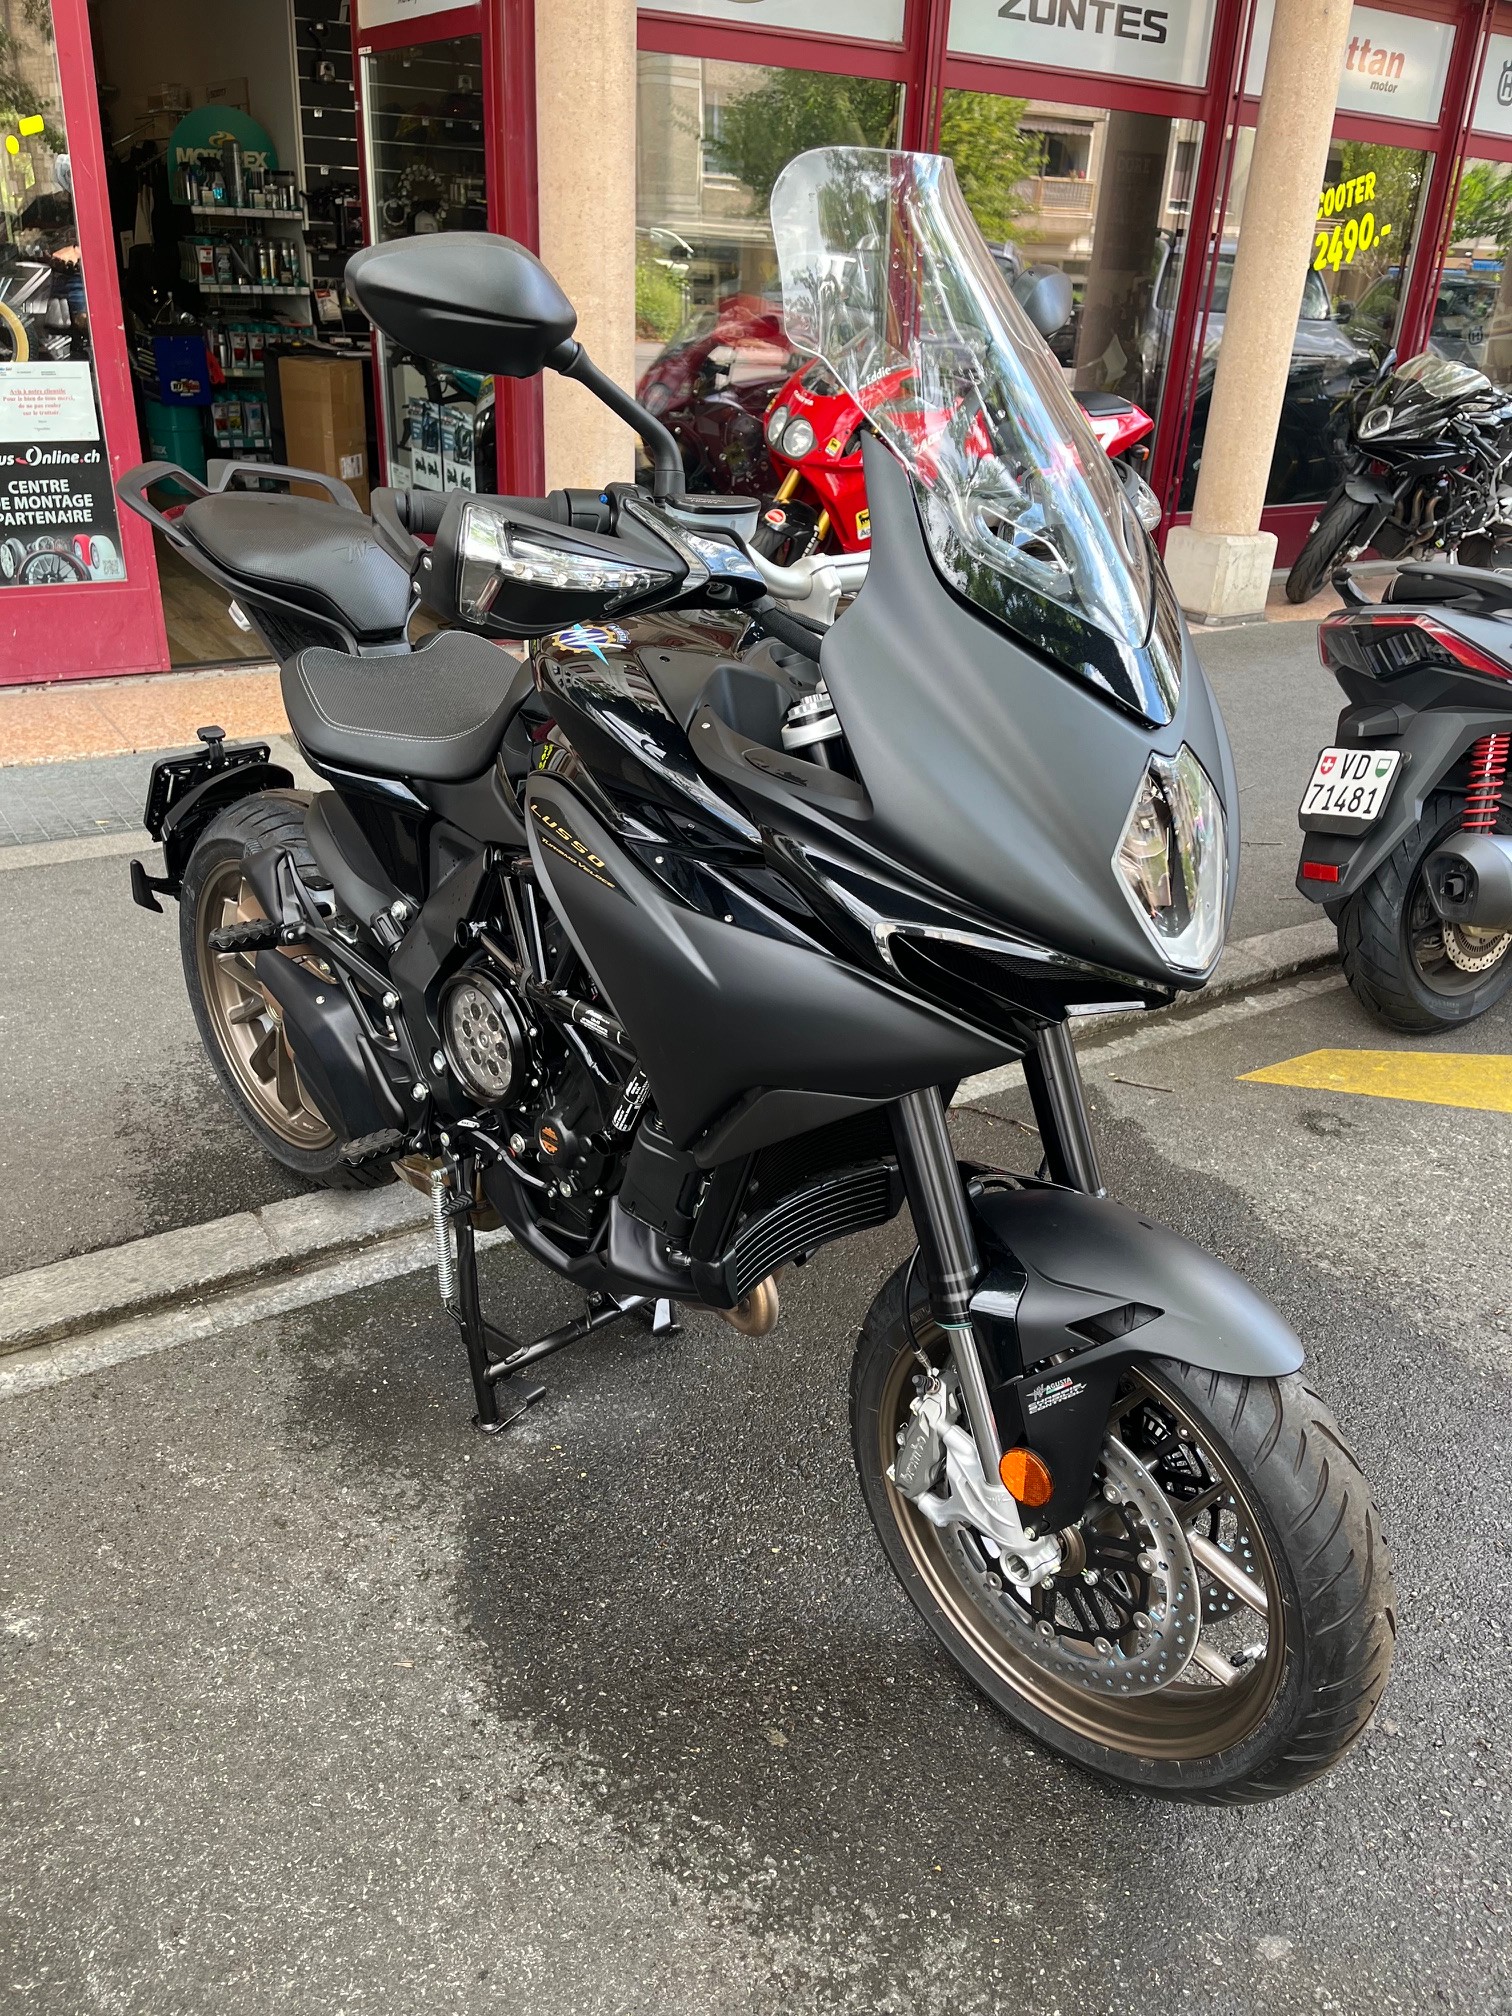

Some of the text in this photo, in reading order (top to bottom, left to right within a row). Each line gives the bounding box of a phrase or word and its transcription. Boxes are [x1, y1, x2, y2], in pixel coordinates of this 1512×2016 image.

[1369, 80, 1398, 94] motor
[1313, 212, 1392, 272] 2490.-
[8, 479, 70, 494] CENTRE
[14, 494, 94, 510] MONTAGE
[1340, 753, 1371, 780] VD
[1308, 784, 1378, 814] 71481
[530, 804, 605, 868] LUSSO
[1046, 1376, 1074, 1391] AGUSTA
